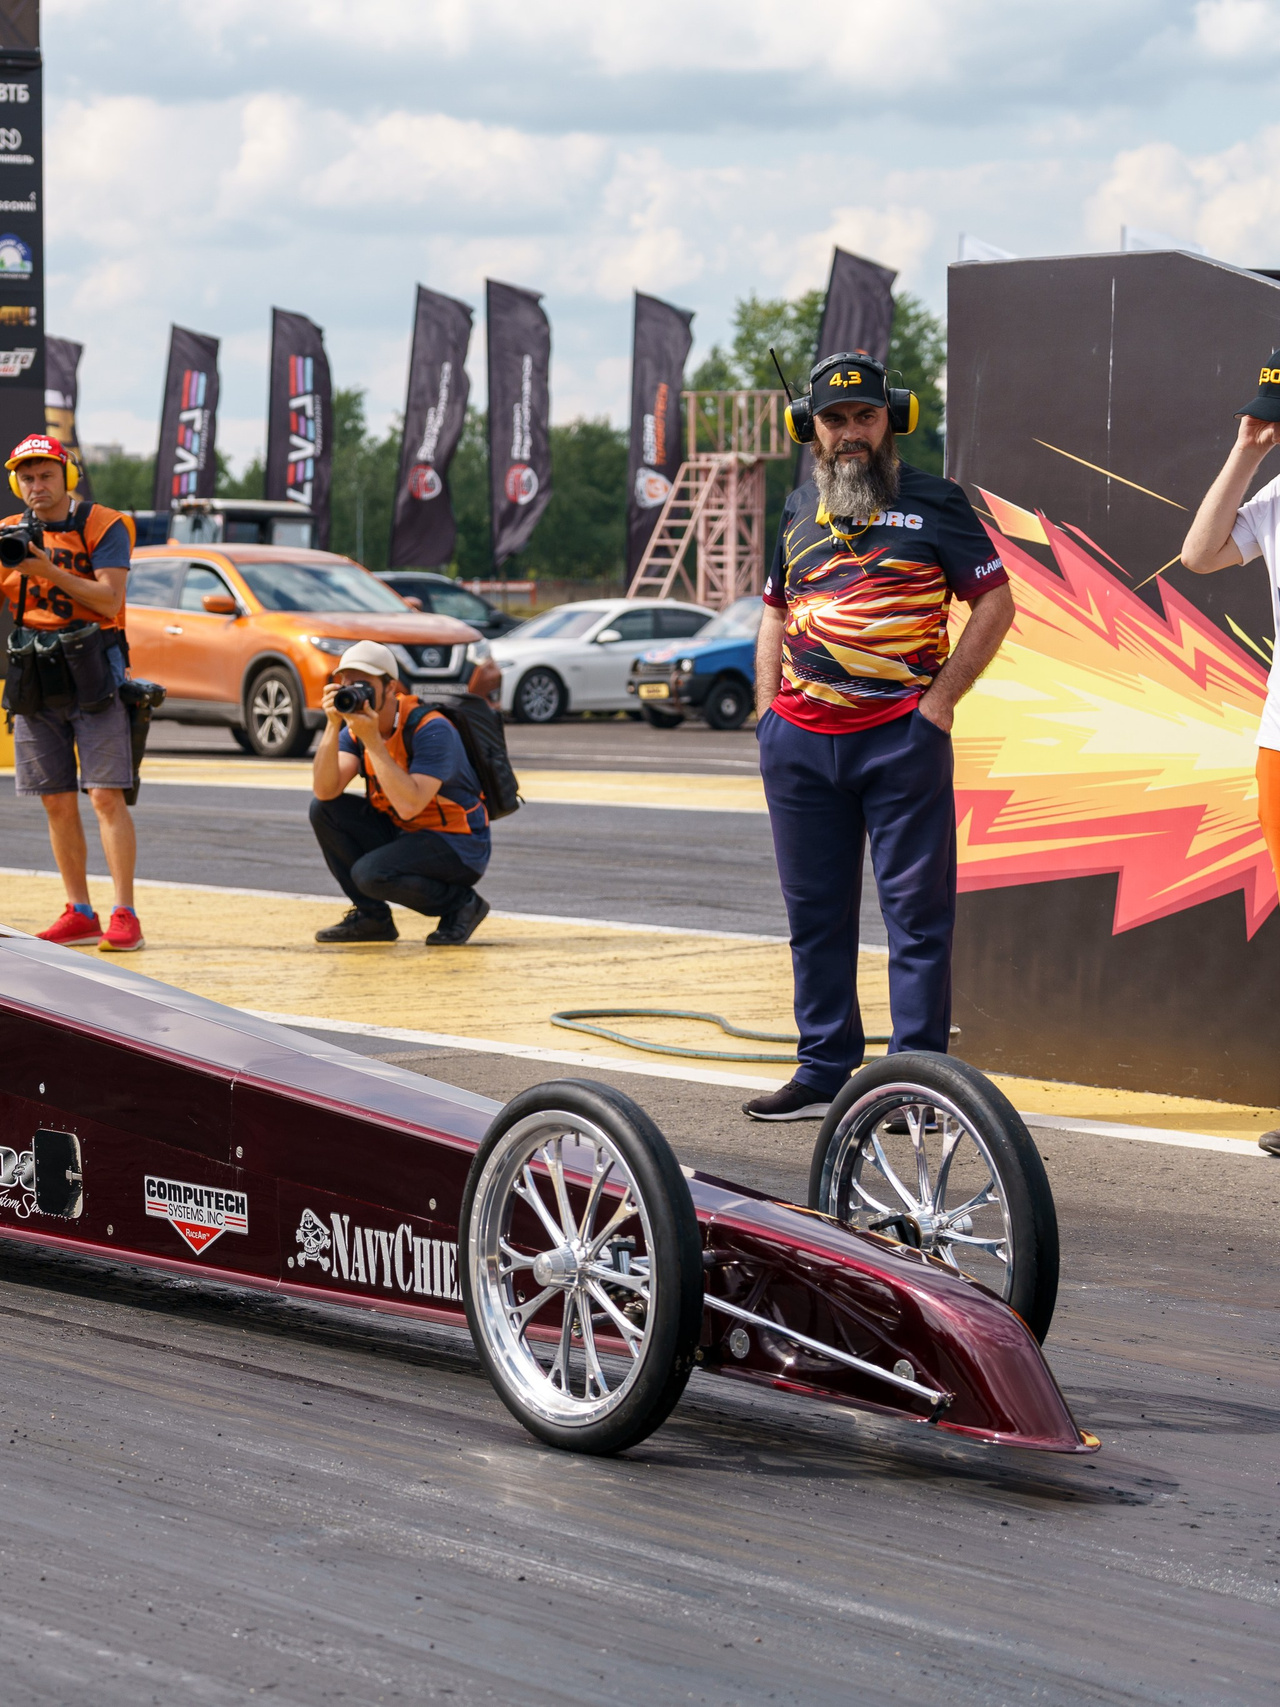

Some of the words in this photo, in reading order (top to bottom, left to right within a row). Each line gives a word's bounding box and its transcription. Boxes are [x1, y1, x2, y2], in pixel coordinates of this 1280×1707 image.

[829, 371, 863, 388] 4,3
[14, 439, 53, 455] LUKOIL
[168, 1202, 207, 1225] SYSTEMS,
[206, 1211, 227, 1227] INC.
